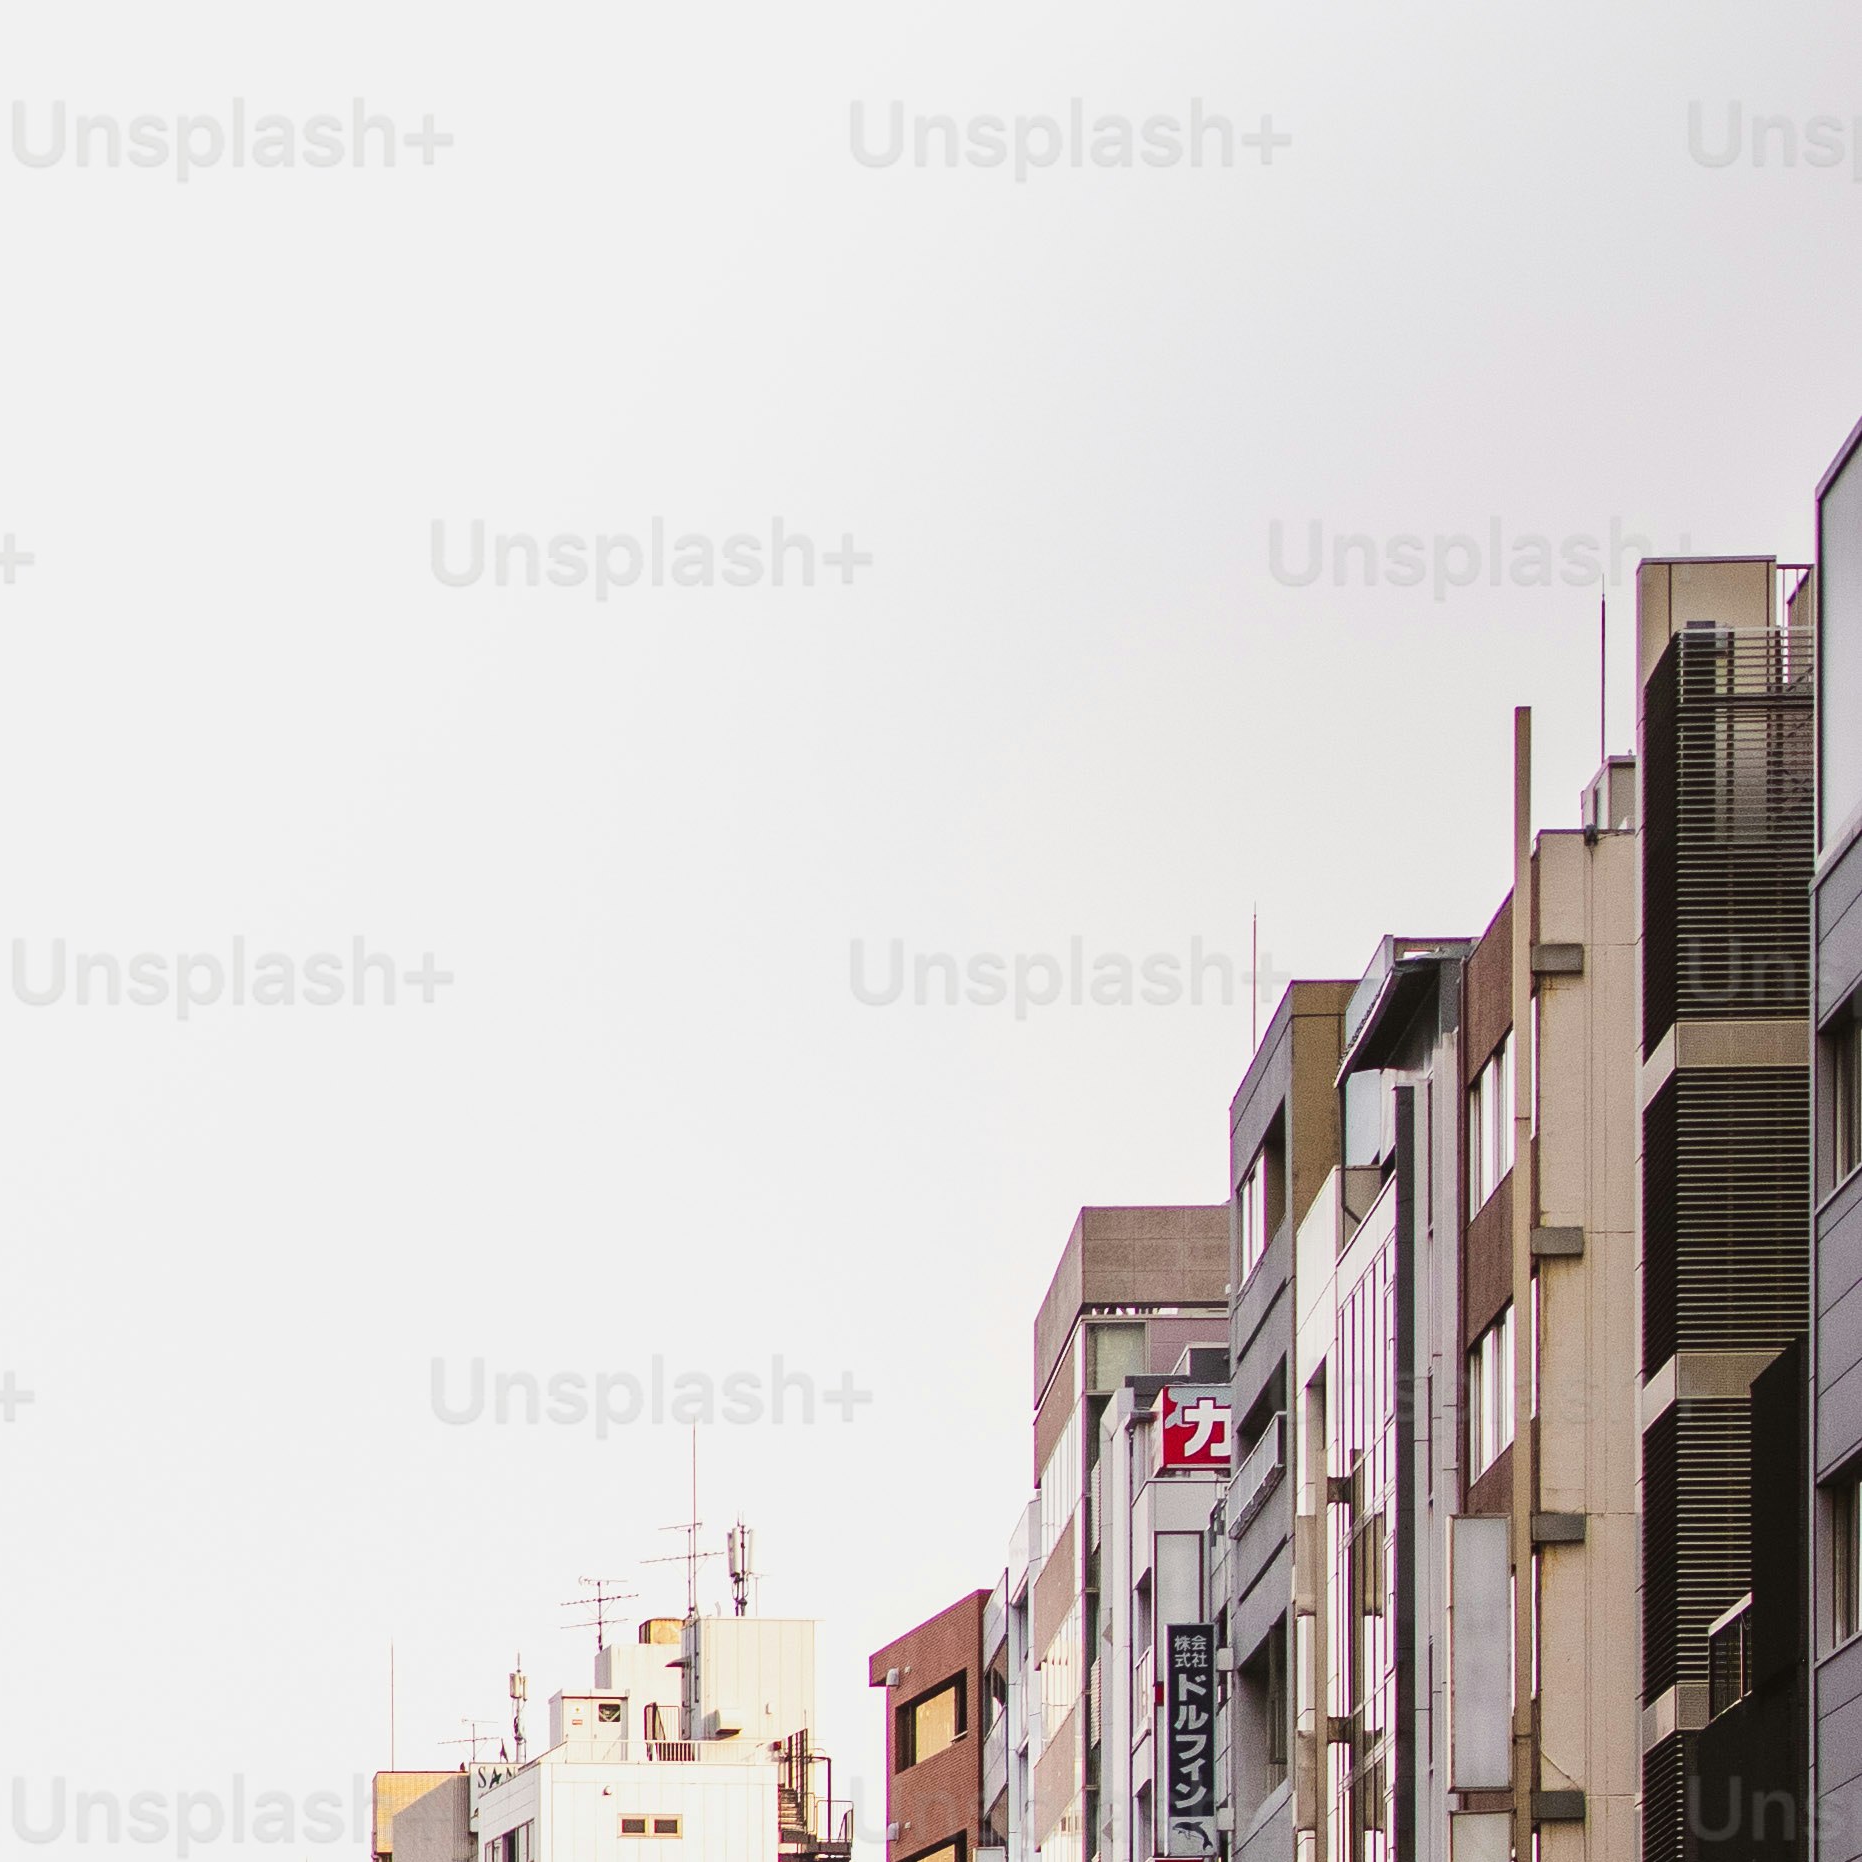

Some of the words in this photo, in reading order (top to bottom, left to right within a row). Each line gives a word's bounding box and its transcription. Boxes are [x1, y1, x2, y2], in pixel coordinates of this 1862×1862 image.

[1184, 1397, 1231, 1456] カ
[1175, 1674, 1207, 1810] ドルフィン
[477, 1765, 519, 1790] SAN
